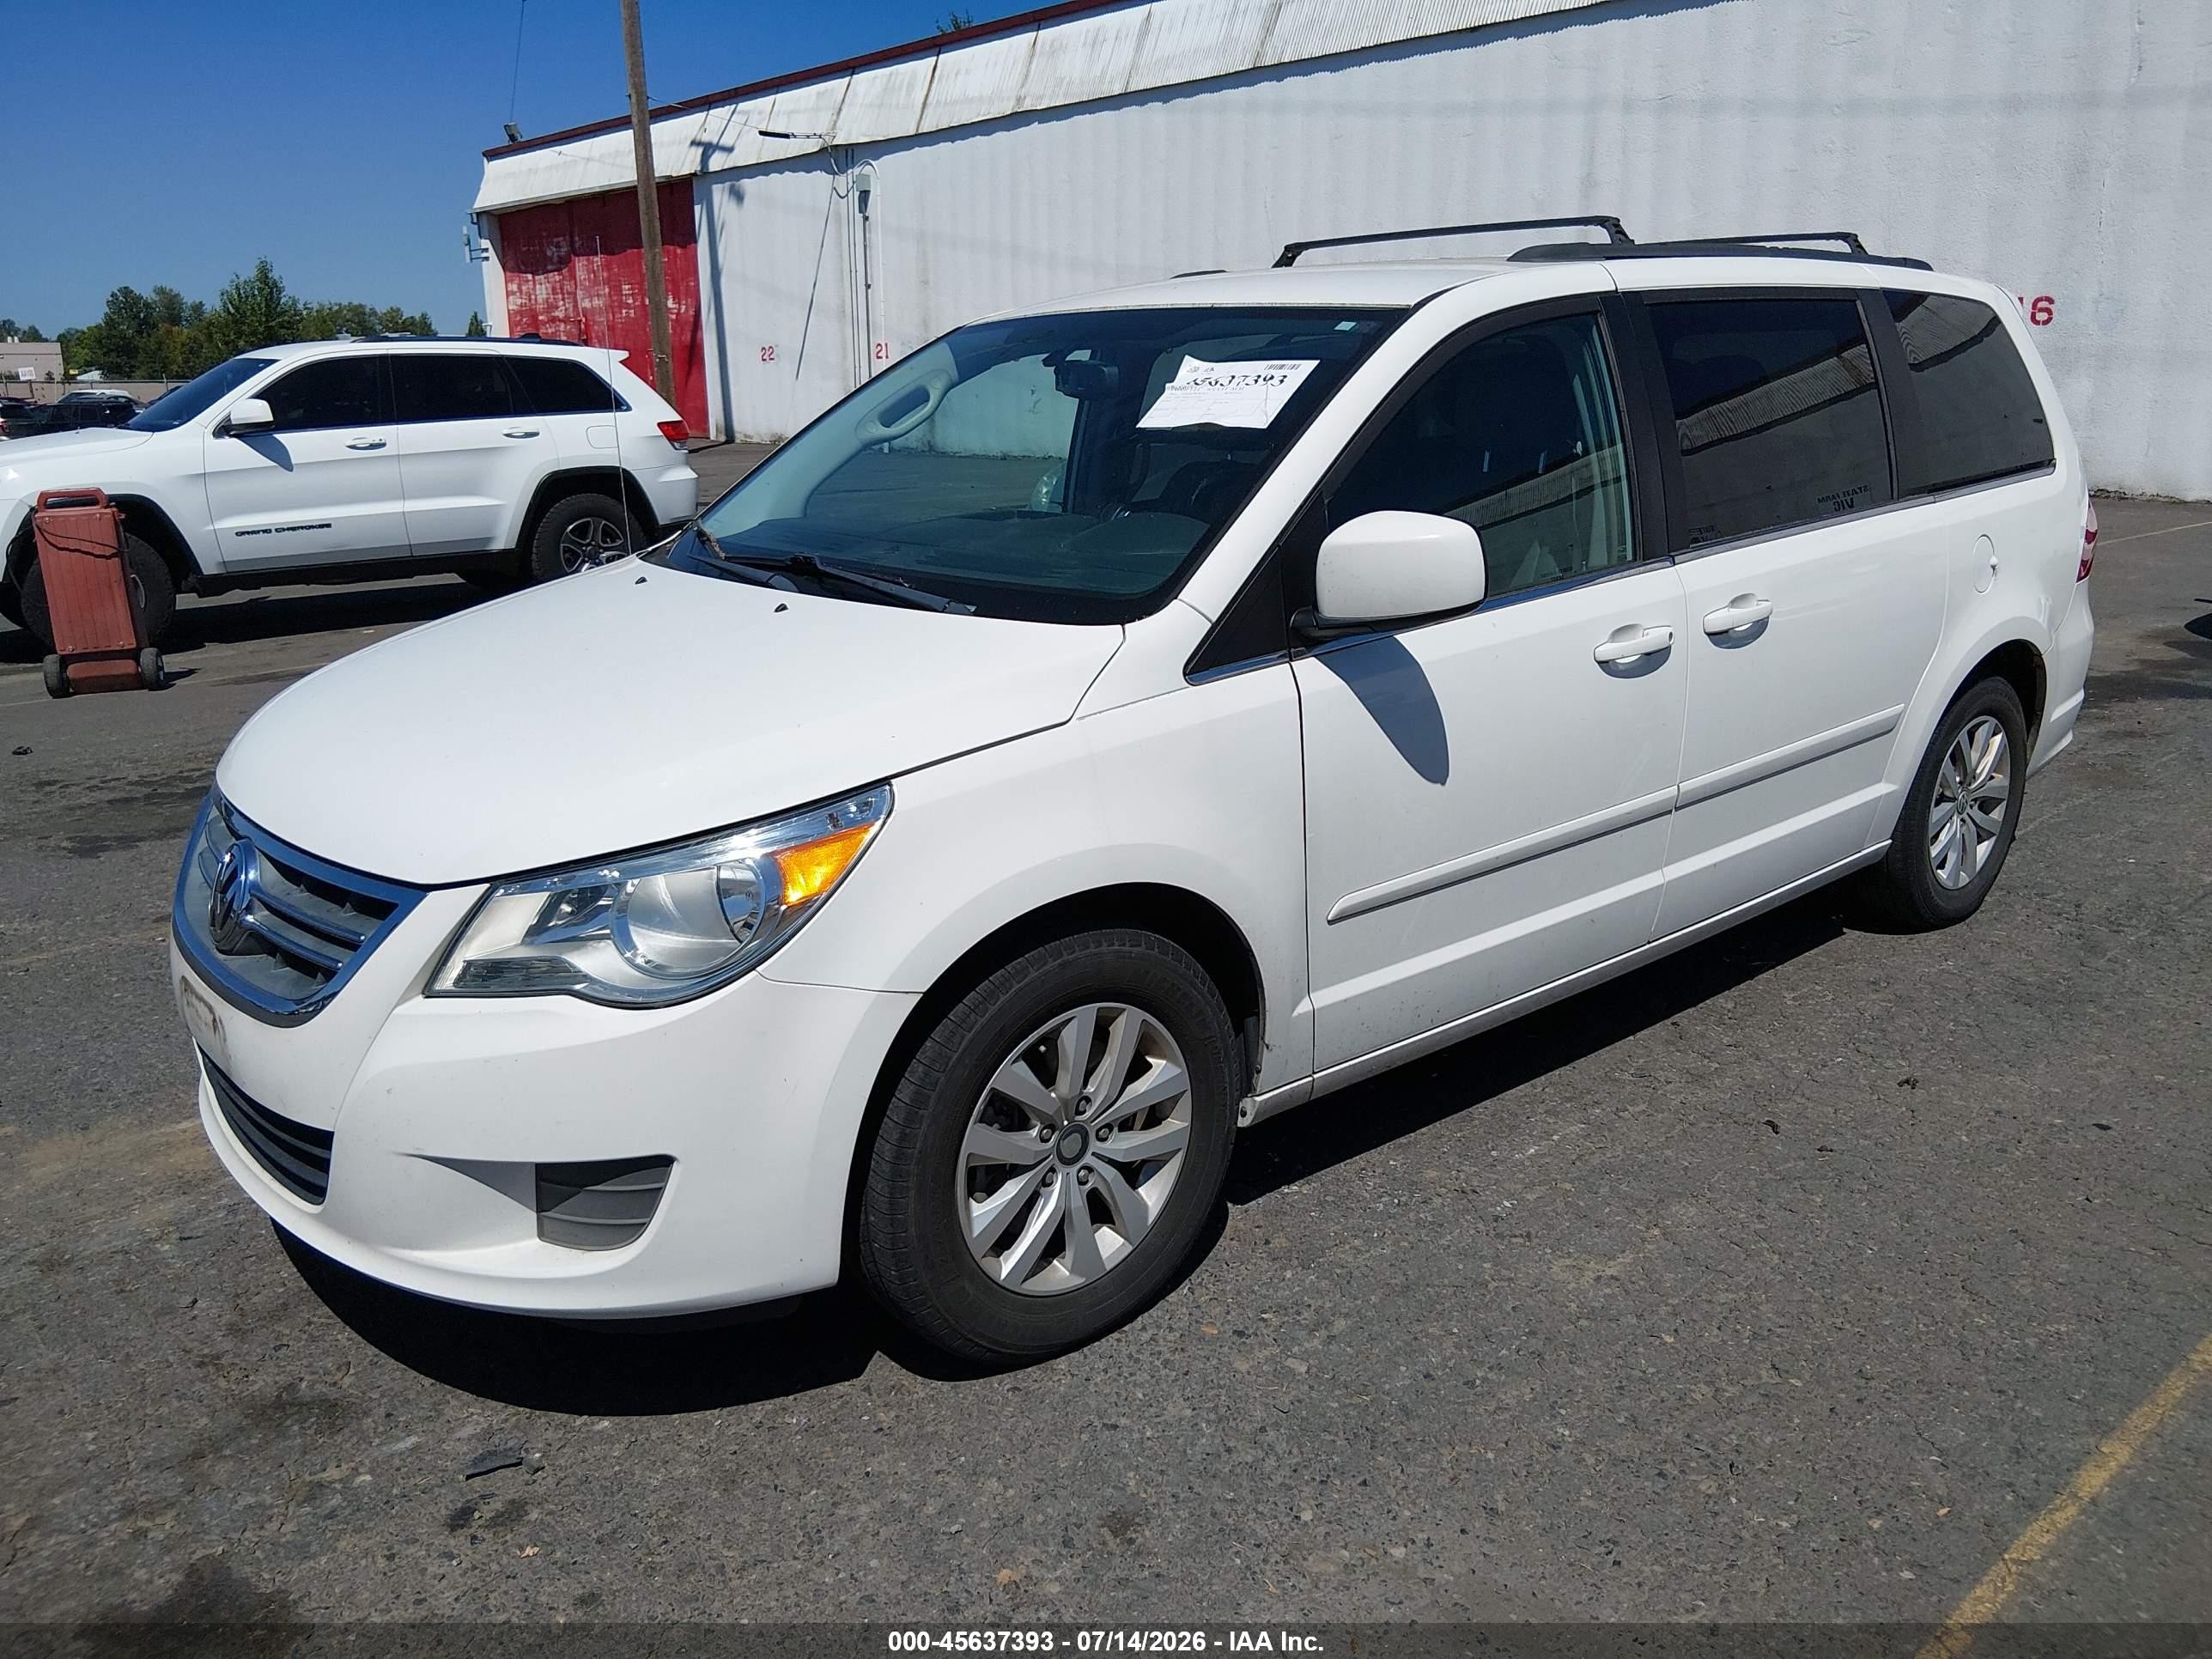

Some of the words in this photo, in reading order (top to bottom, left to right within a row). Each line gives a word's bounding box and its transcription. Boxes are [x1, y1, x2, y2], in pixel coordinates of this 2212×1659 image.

[2017, 295, 2055, 326] 6
[761, 345, 775, 361] 22
[875, 343, 889, 360] 21
